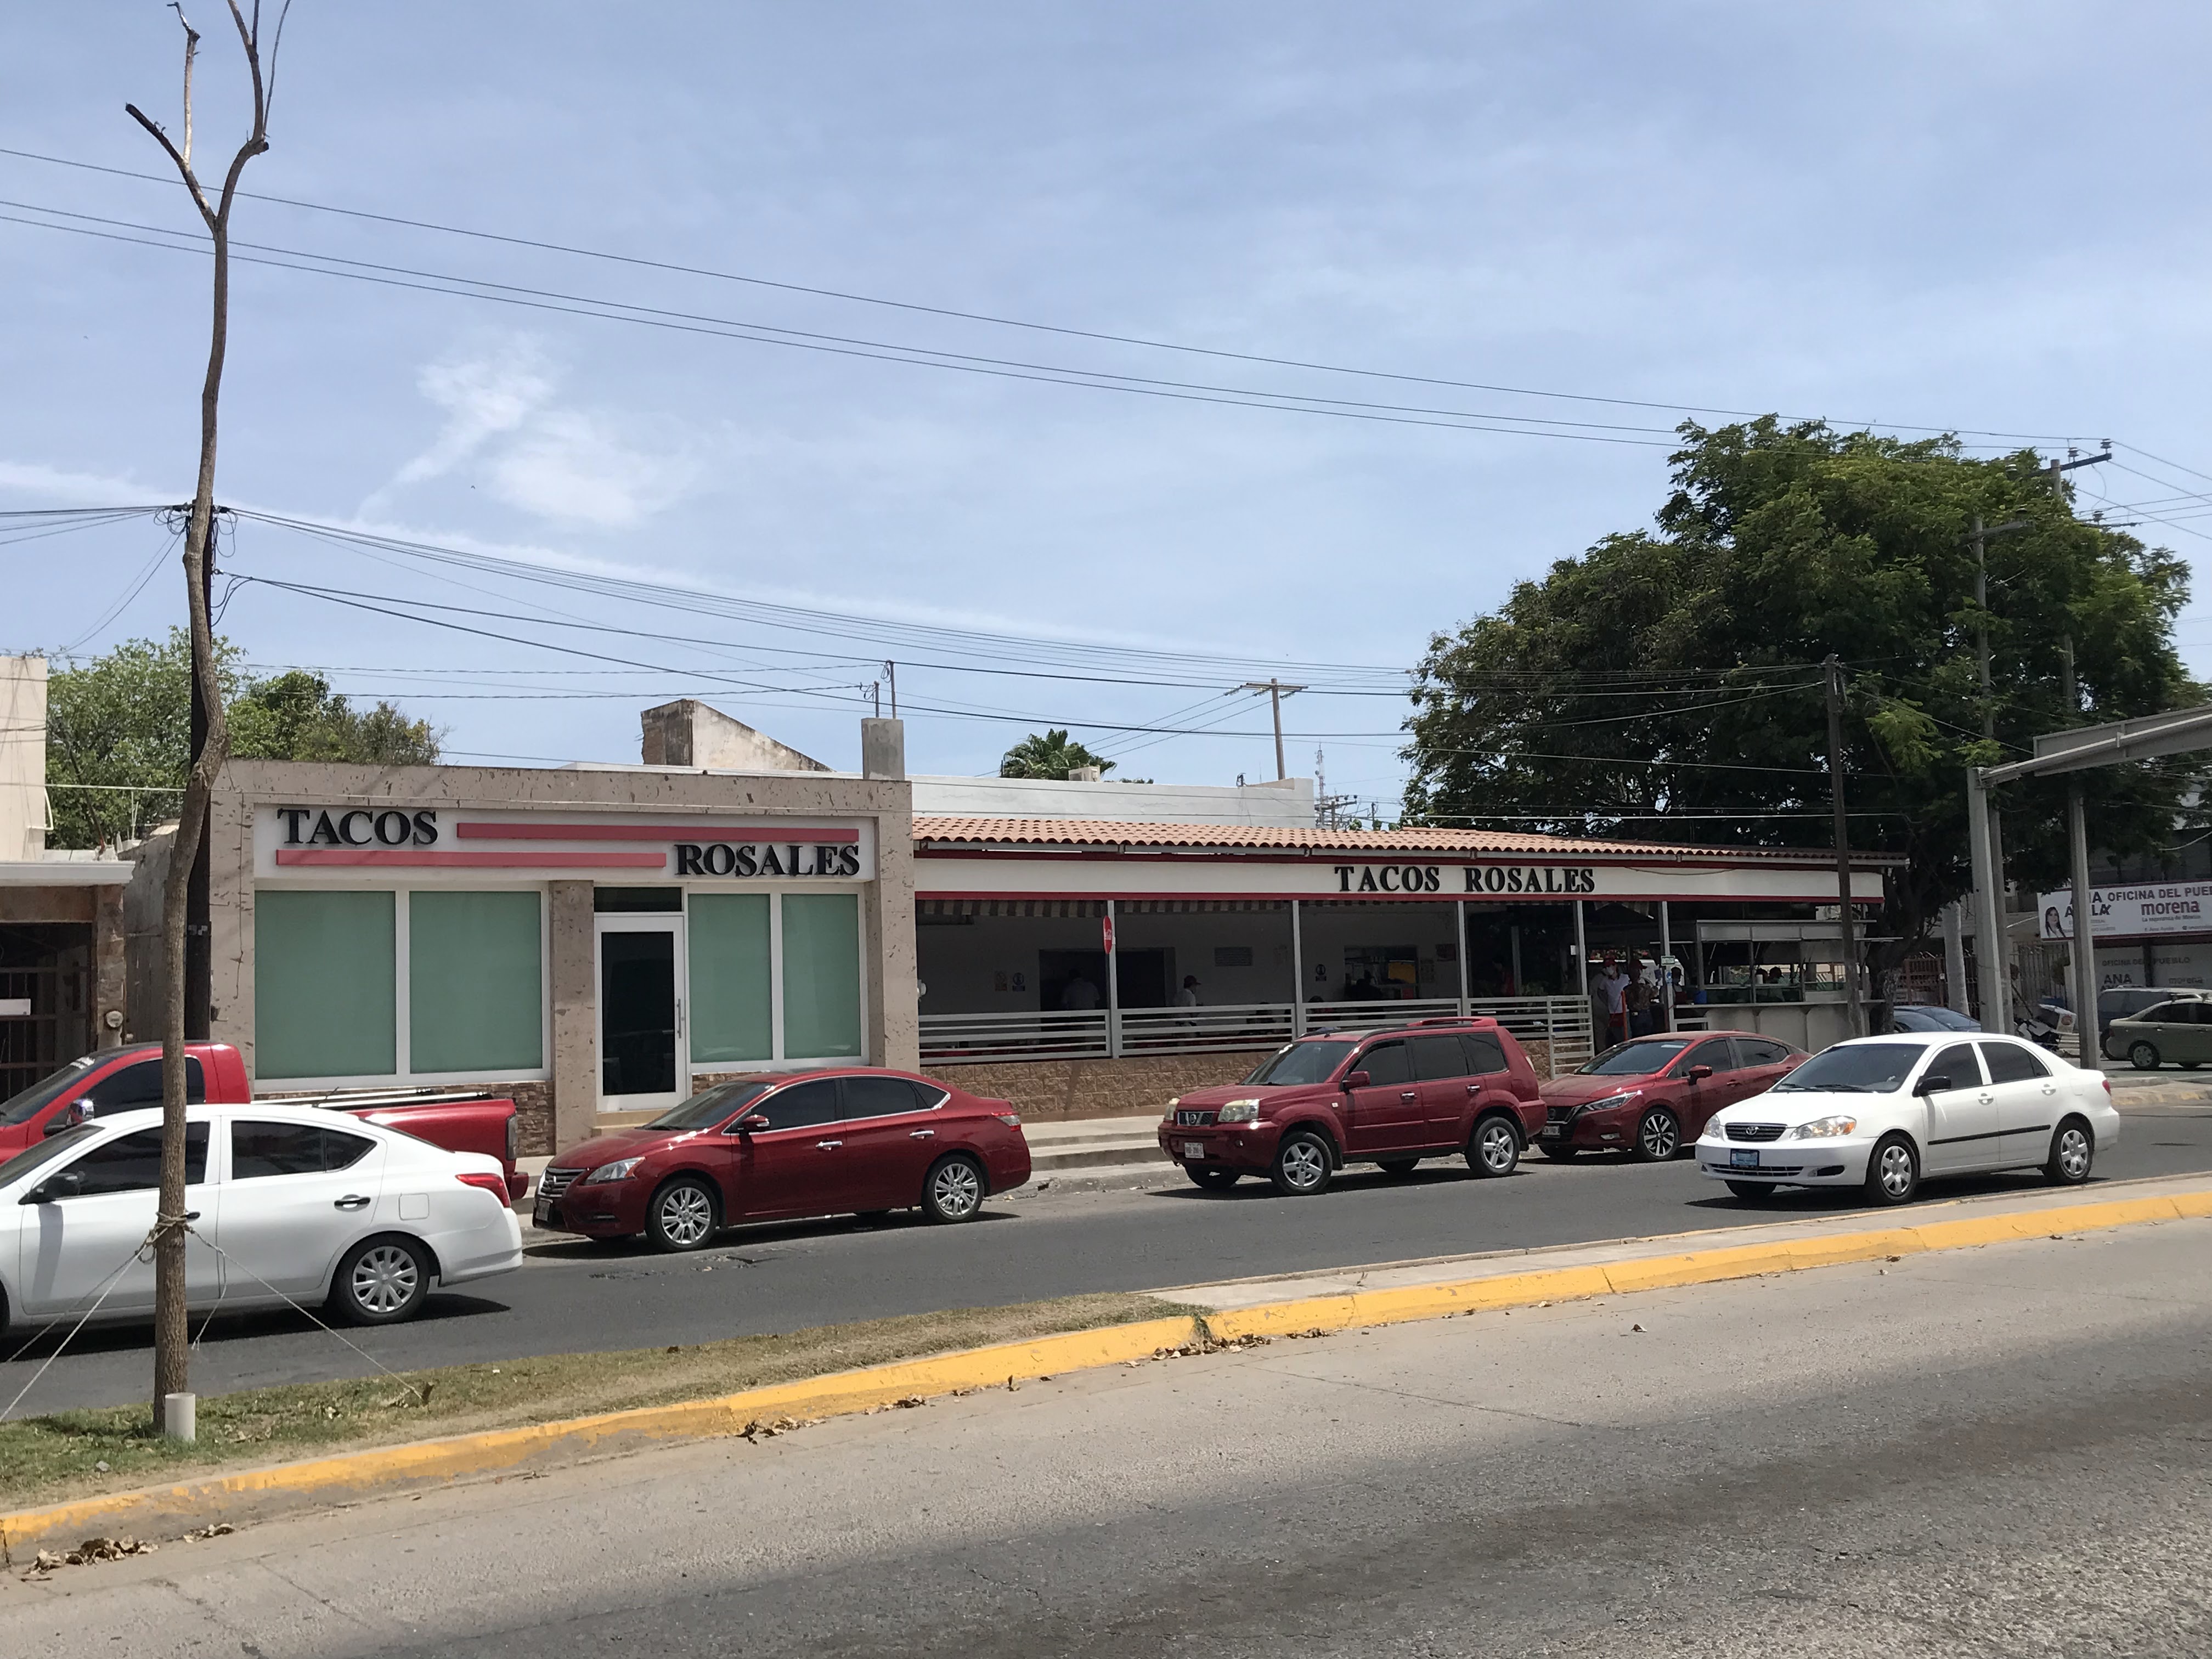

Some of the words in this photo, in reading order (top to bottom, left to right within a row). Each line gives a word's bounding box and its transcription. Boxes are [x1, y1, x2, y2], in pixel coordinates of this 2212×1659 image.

[277, 808, 438, 846] TACOS
[674, 843, 860, 877] ROSALES
[1334, 866, 1441, 892] TACOS
[1463, 867, 1595, 893] ROSALES
[2107, 889, 2155, 901] OFICINA
[2158, 888, 2181, 899] DEL
[2141, 900, 2200, 916] morena
[2104, 973, 2132, 984] ANA
